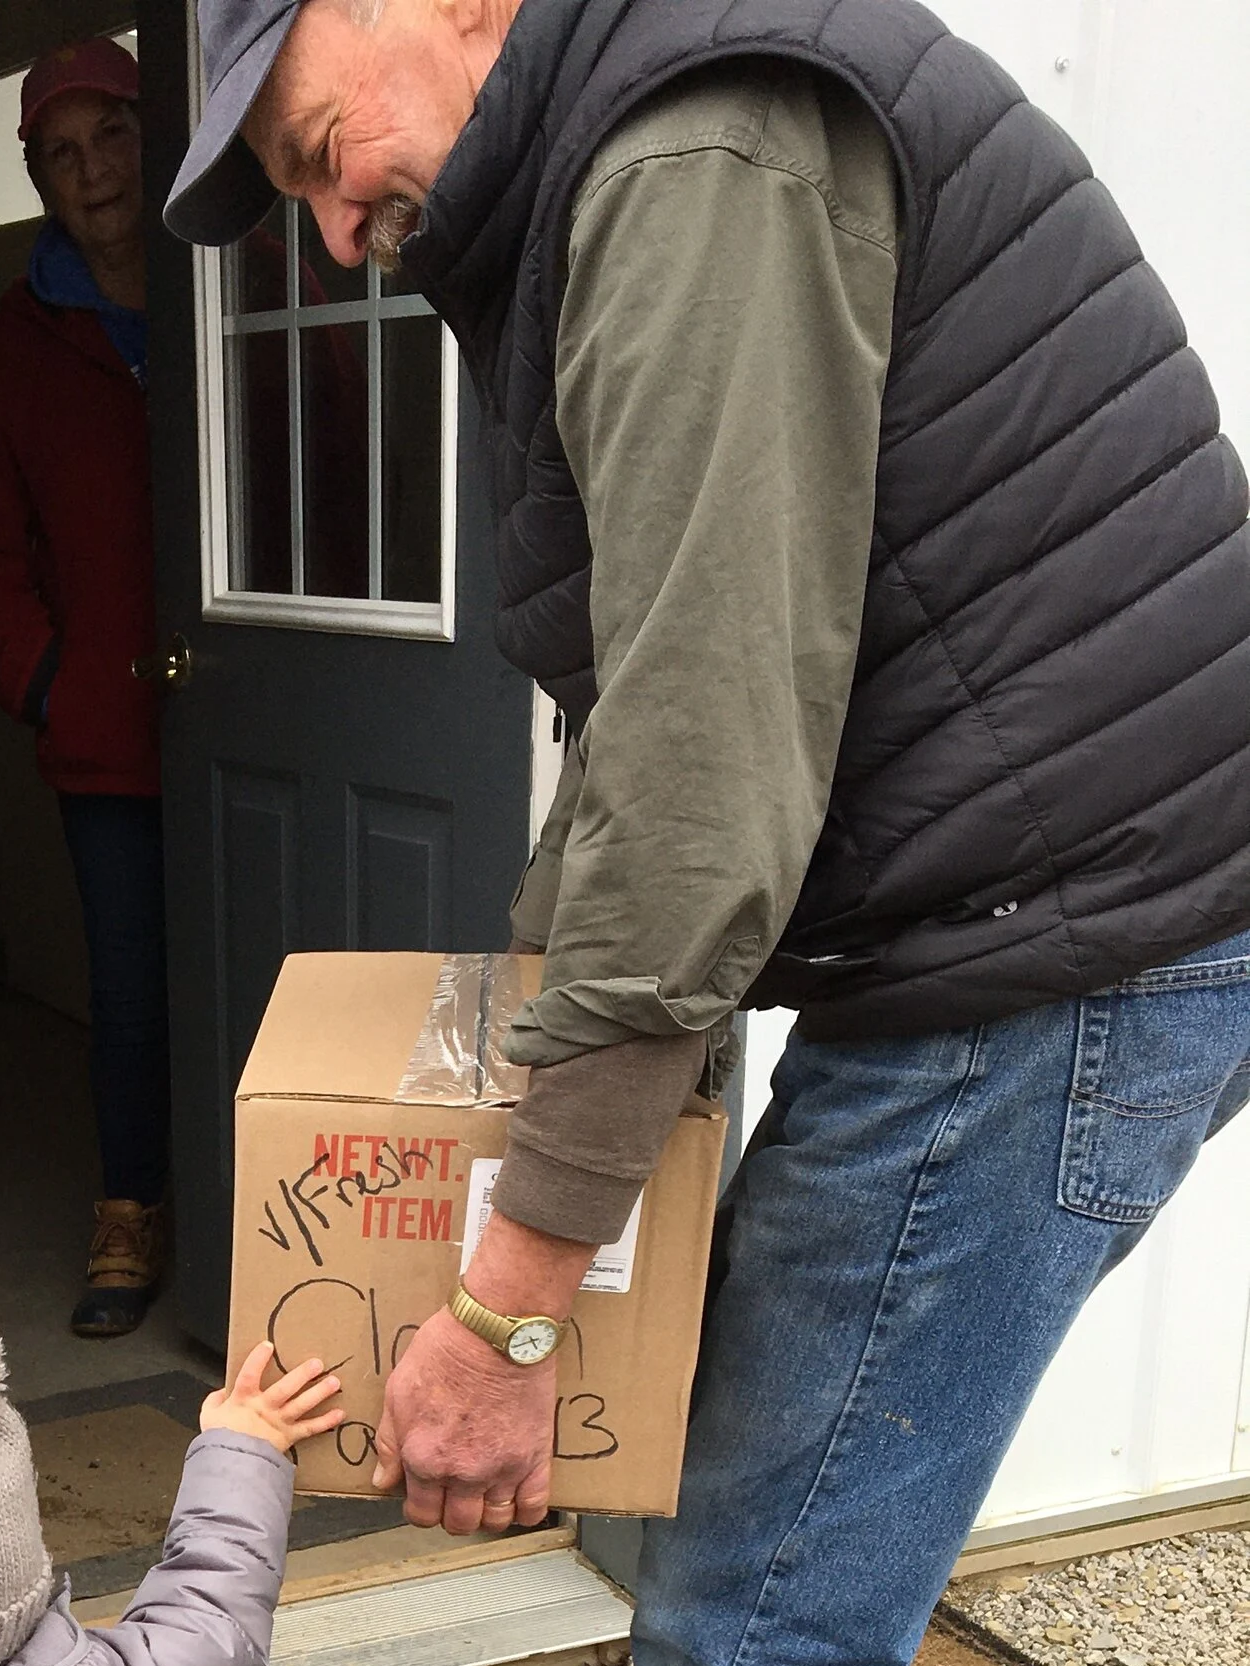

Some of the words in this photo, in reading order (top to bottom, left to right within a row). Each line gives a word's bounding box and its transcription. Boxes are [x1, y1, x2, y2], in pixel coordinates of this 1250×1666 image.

[313, 1133, 389, 1179] NET
[397, 1137, 464, 1183] WT.
[361, 1196, 454, 1242] ITEM
